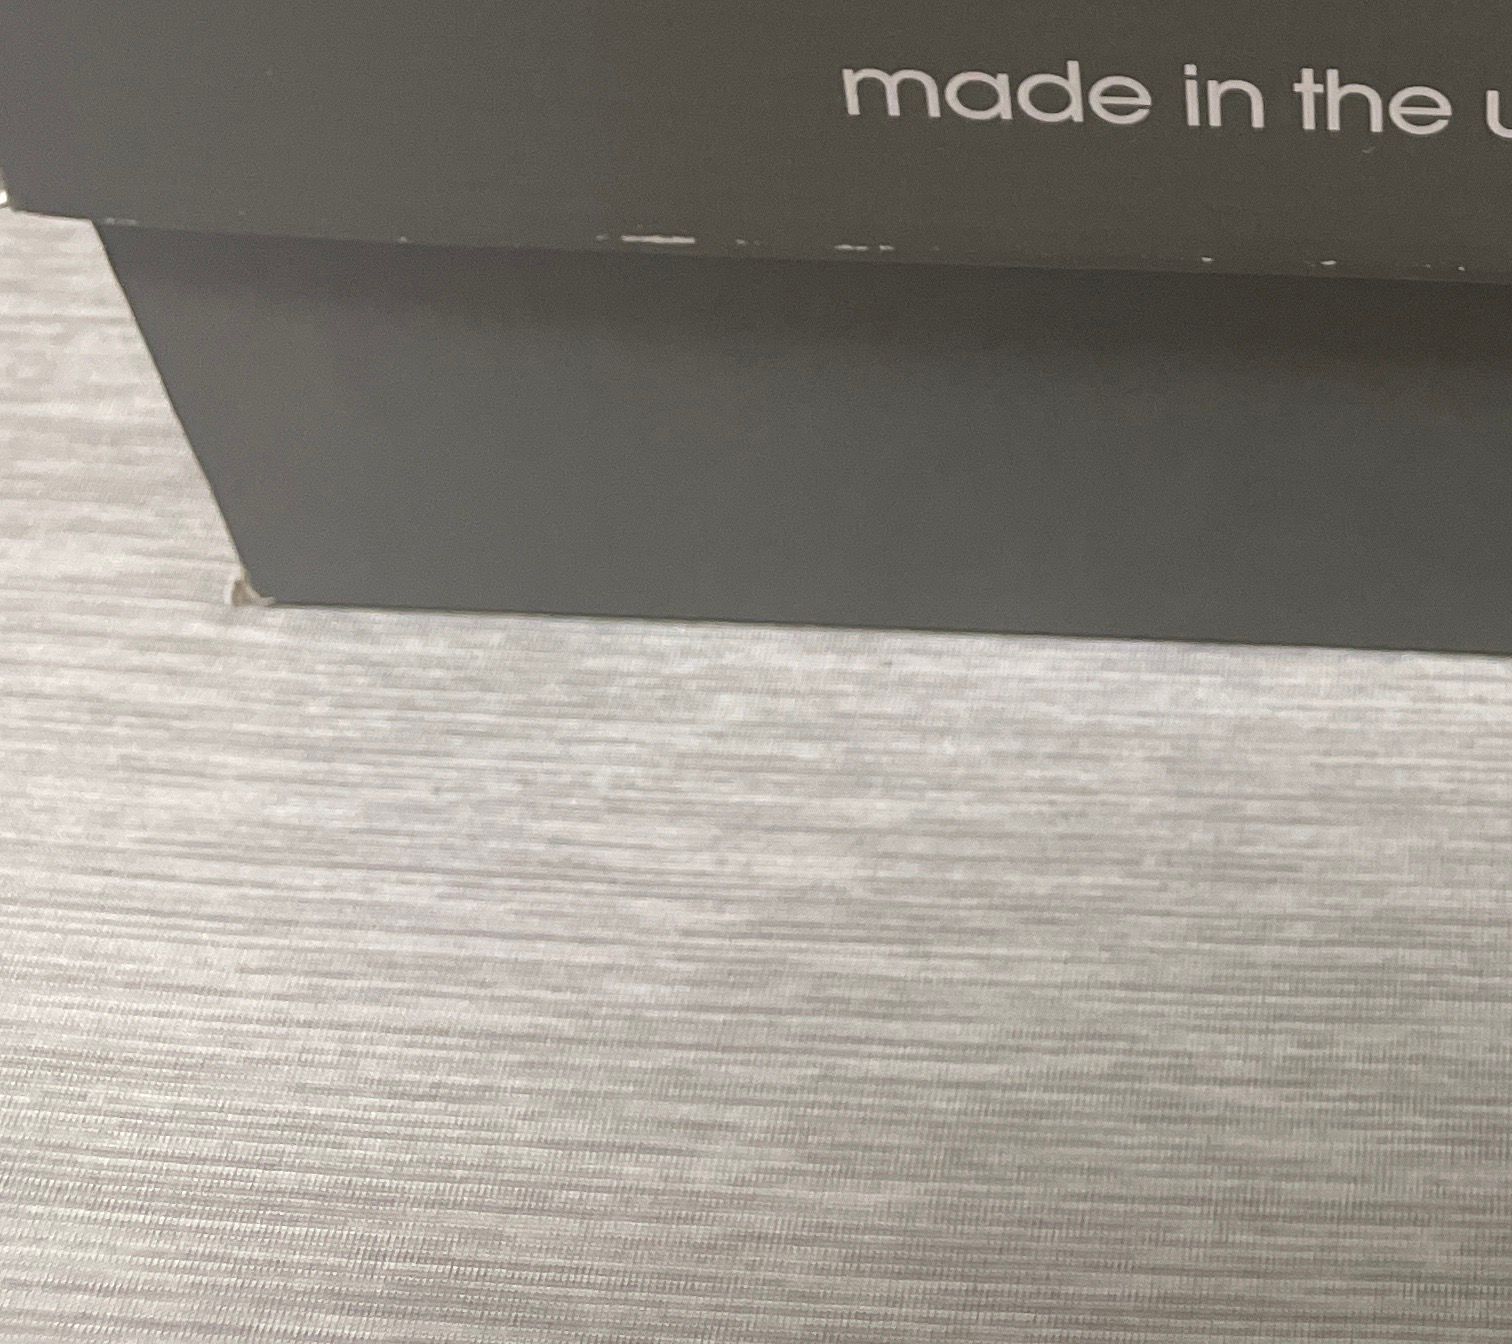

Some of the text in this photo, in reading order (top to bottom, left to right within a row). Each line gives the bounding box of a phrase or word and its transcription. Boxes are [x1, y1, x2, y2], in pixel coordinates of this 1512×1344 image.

[842, 59, 1153, 126] made
[1183, 63, 1265, 129] in
[1292, 67, 1453, 136] the
